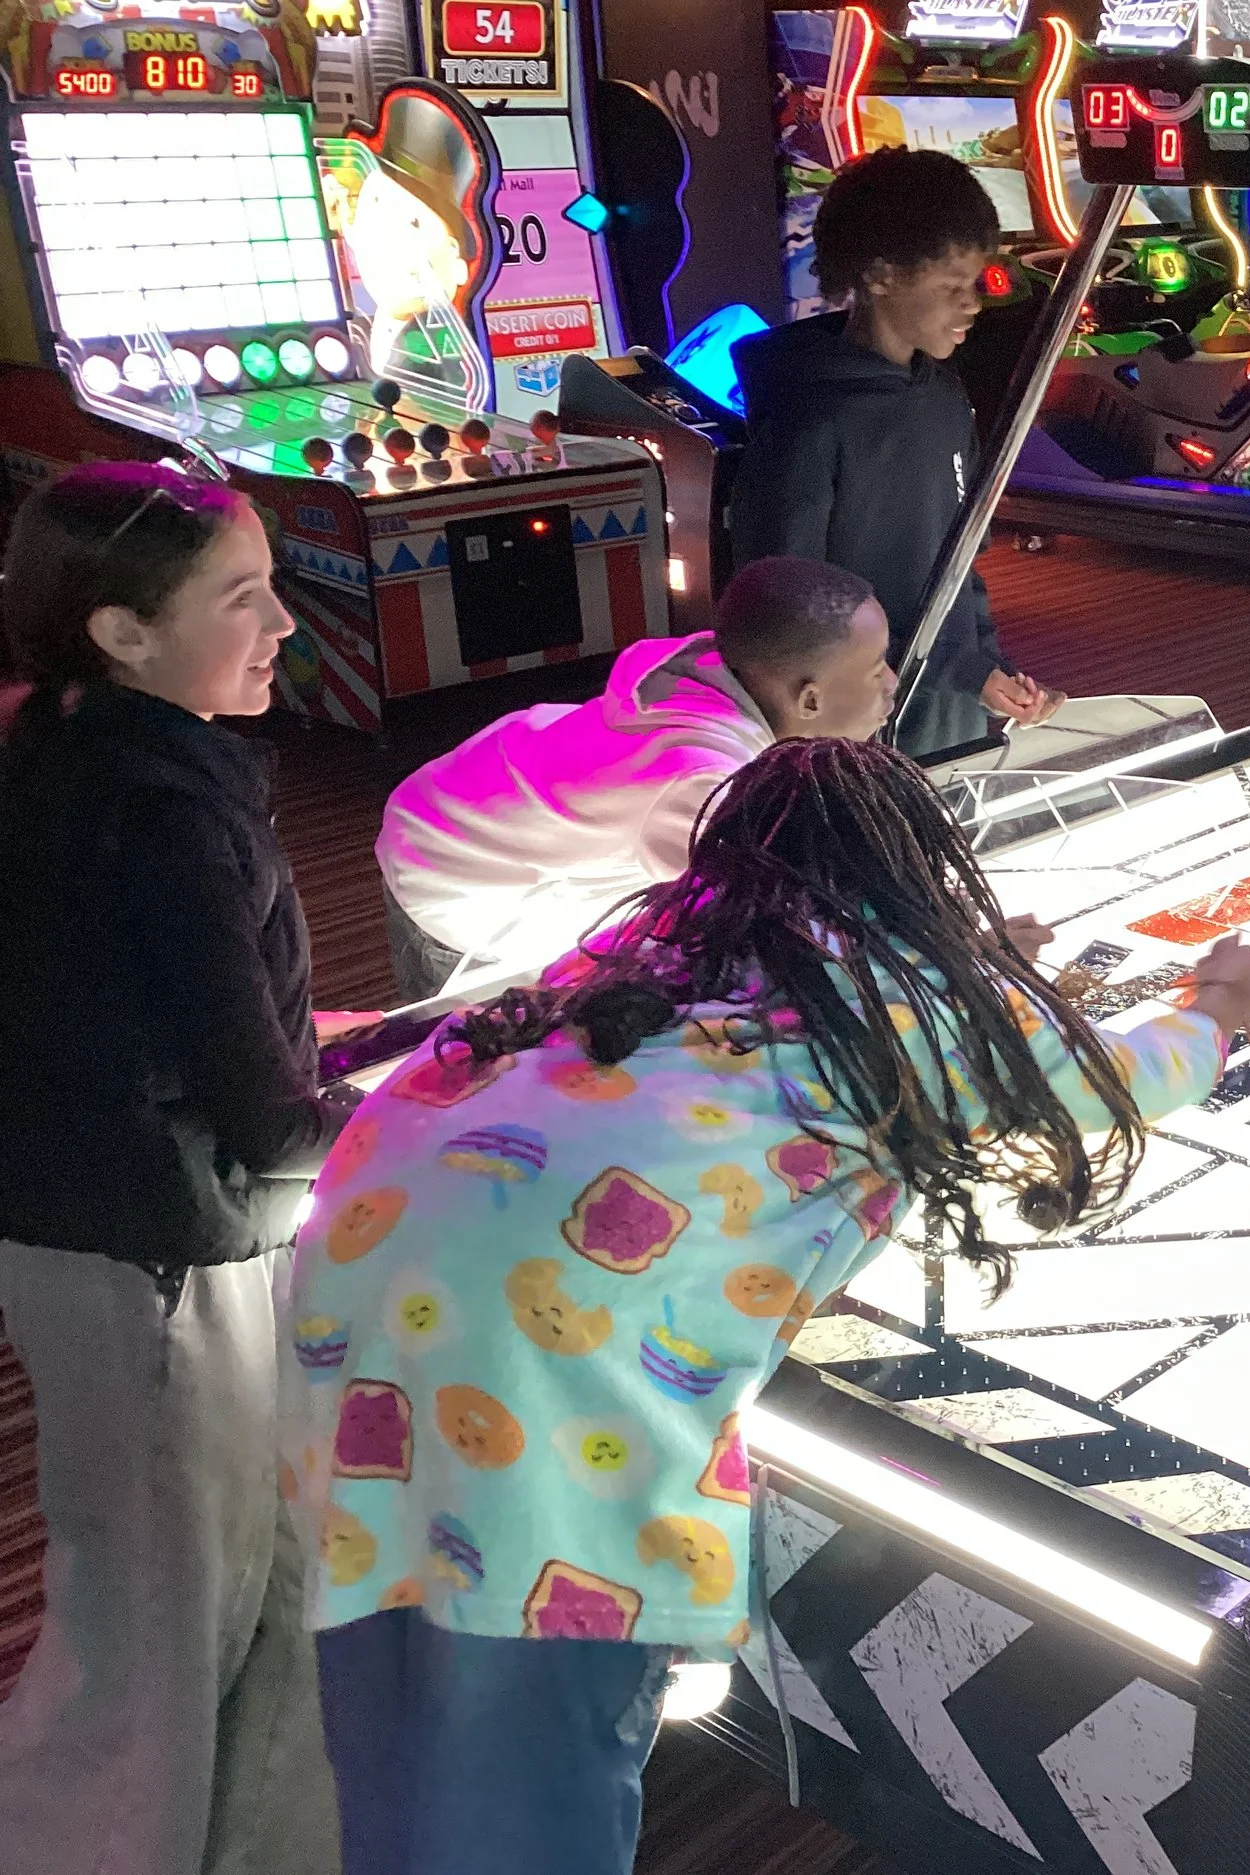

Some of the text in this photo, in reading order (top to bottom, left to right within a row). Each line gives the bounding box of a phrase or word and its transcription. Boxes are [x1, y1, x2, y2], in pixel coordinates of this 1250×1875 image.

[474, 9, 514, 44] 54
[126, 31, 198, 52] BONUS
[59, 73, 112, 94] 5400
[441, 59, 548, 84] TICKETS!
[234, 75, 258, 95] 30
[1089, 91, 1125, 125] 03
[1208, 91, 1249, 128] 02
[1160, 128, 1177, 162] 0
[510, 177, 534, 191] Mall
[486, 310, 587, 336] NSERT COIN
[513, 334, 545, 348] CREDIT
